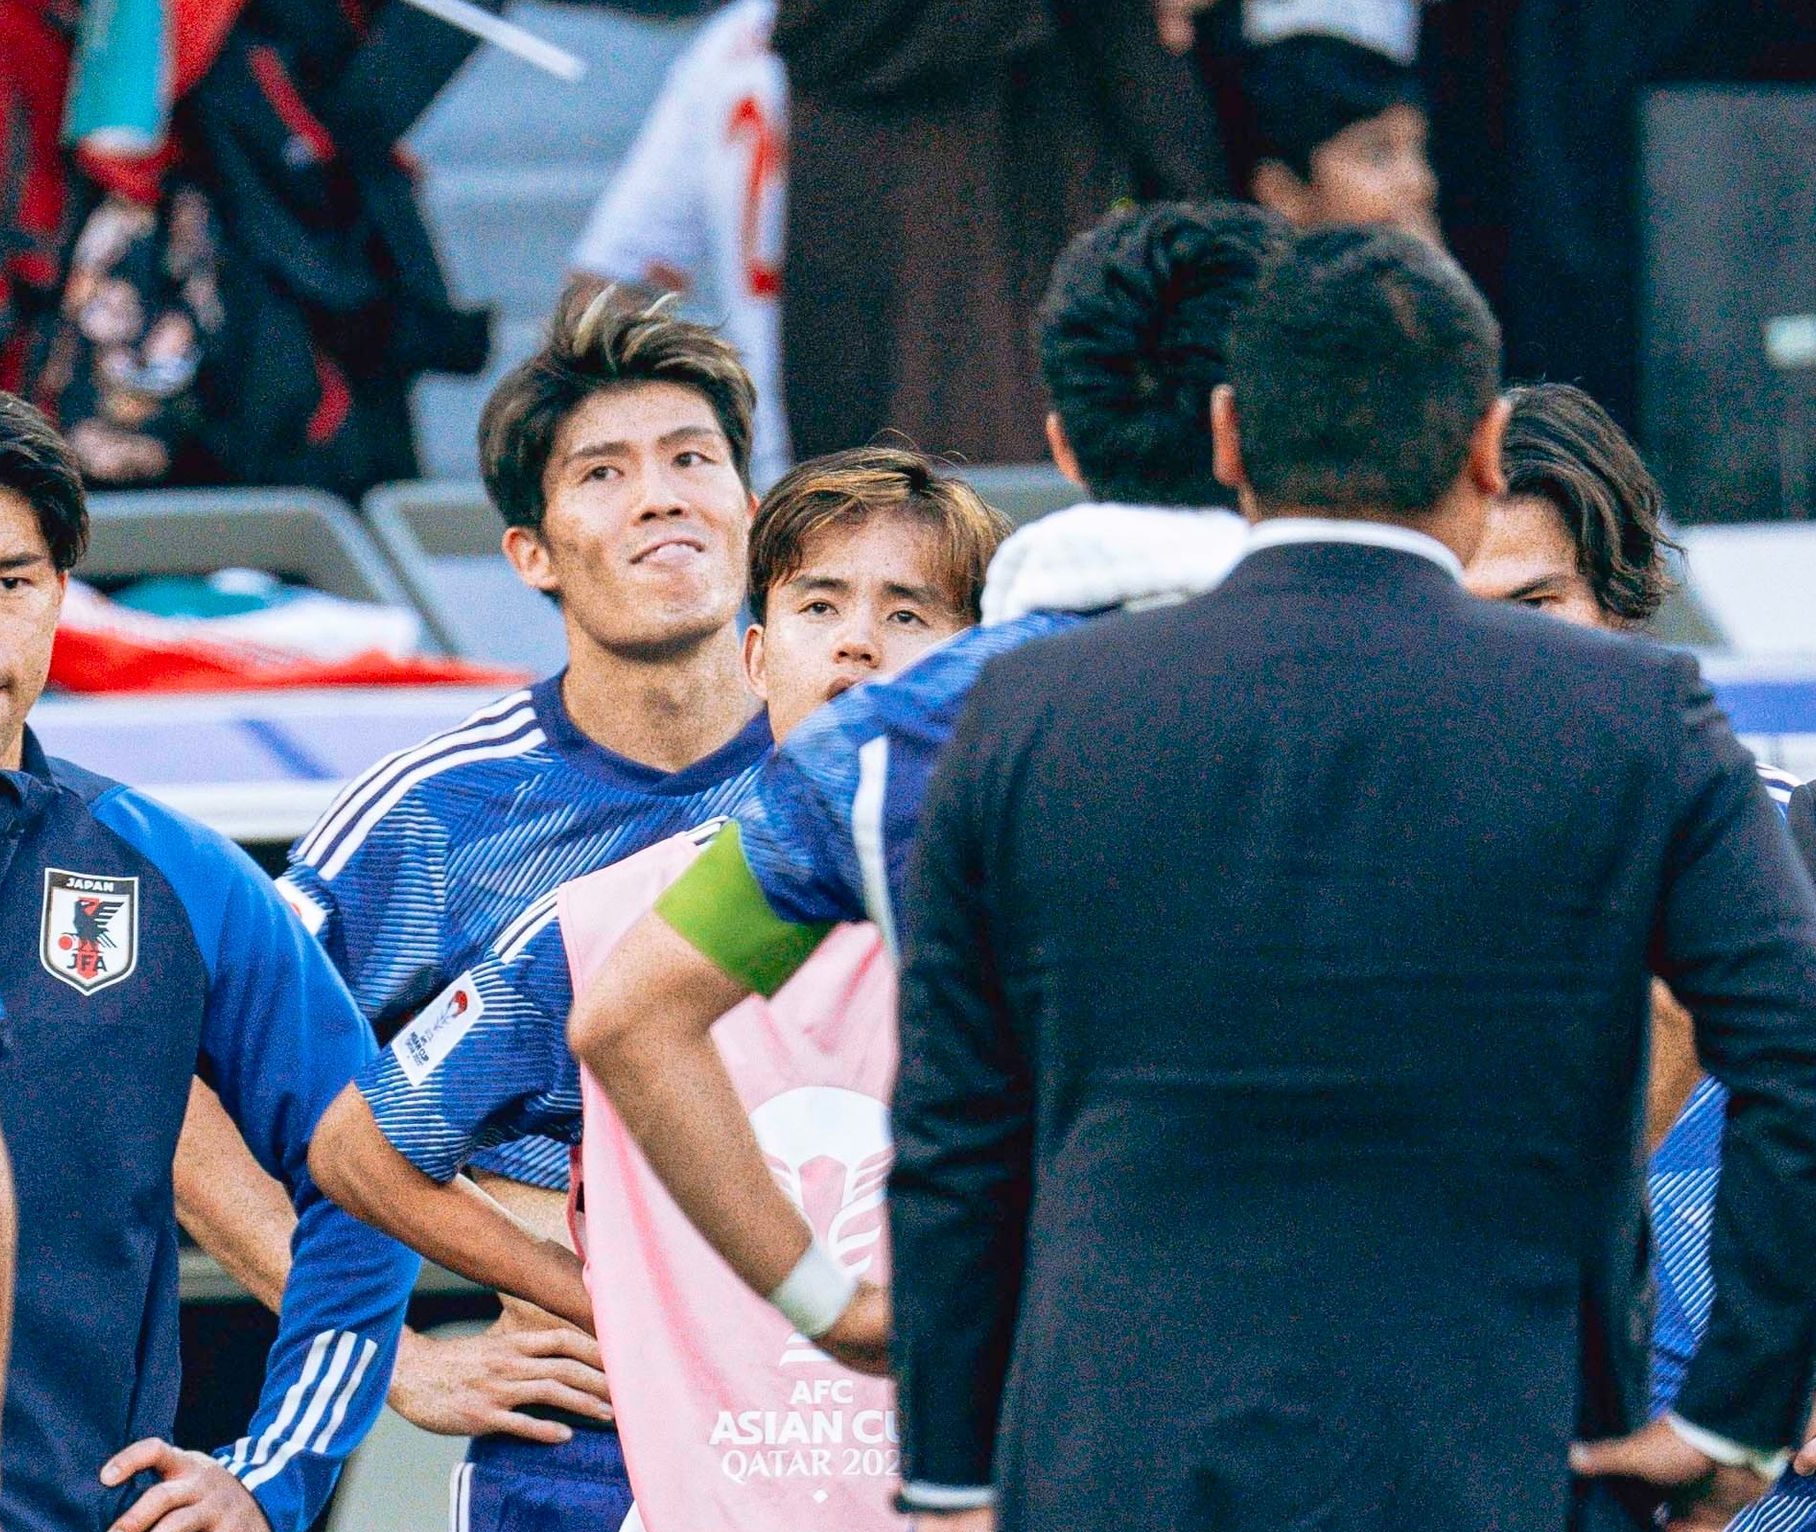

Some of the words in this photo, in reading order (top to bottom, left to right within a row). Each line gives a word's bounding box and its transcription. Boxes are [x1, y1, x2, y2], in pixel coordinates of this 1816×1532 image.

[66, 877, 114, 892] JAPAN
[66, 953, 108, 972] JFA
[789, 1379, 854, 1405] AFC
[708, 1410, 843, 1445] ASIAN
[852, 1409, 901, 1445] CU
[721, 1449, 833, 1484] QATAR
[841, 1448, 902, 1477] 202
